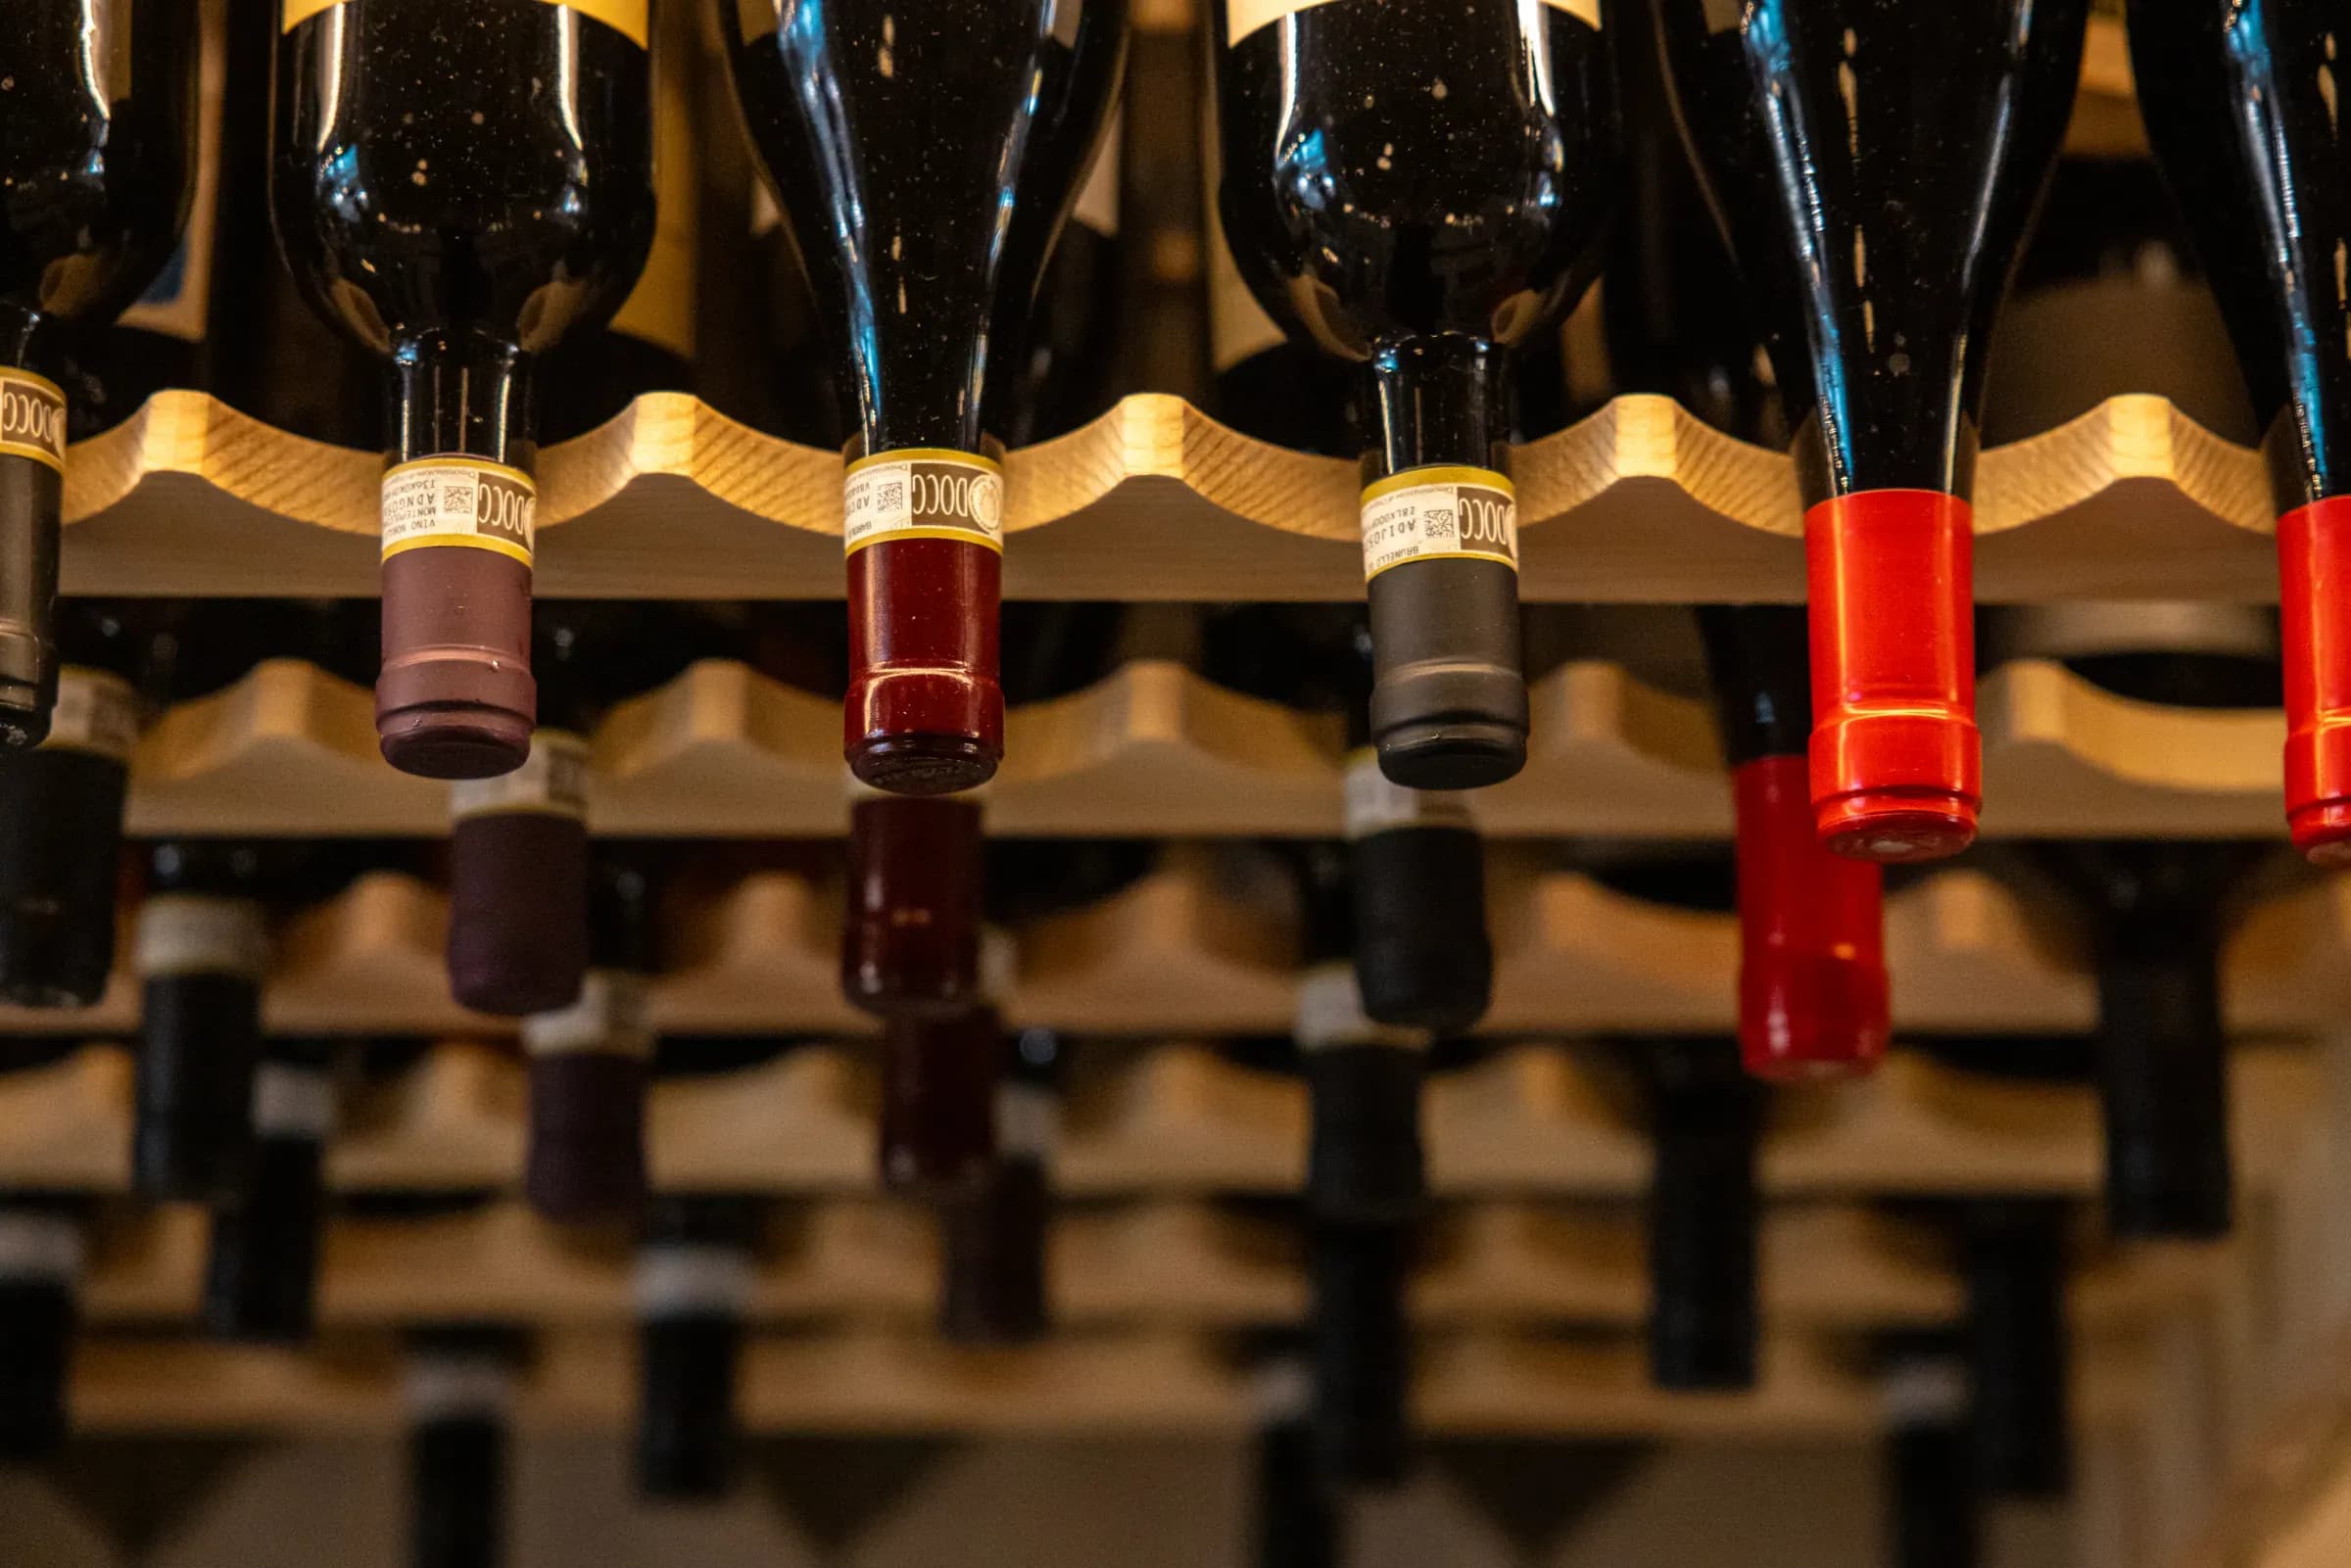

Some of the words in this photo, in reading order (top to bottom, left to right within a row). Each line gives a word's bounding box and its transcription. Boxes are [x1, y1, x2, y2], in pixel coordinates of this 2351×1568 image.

[3, 392, 51, 443] DOCG
[478, 484, 525, 535] DOCG
[912, 474, 968, 517] DOCG
[1459, 498, 1507, 545] DOCG
